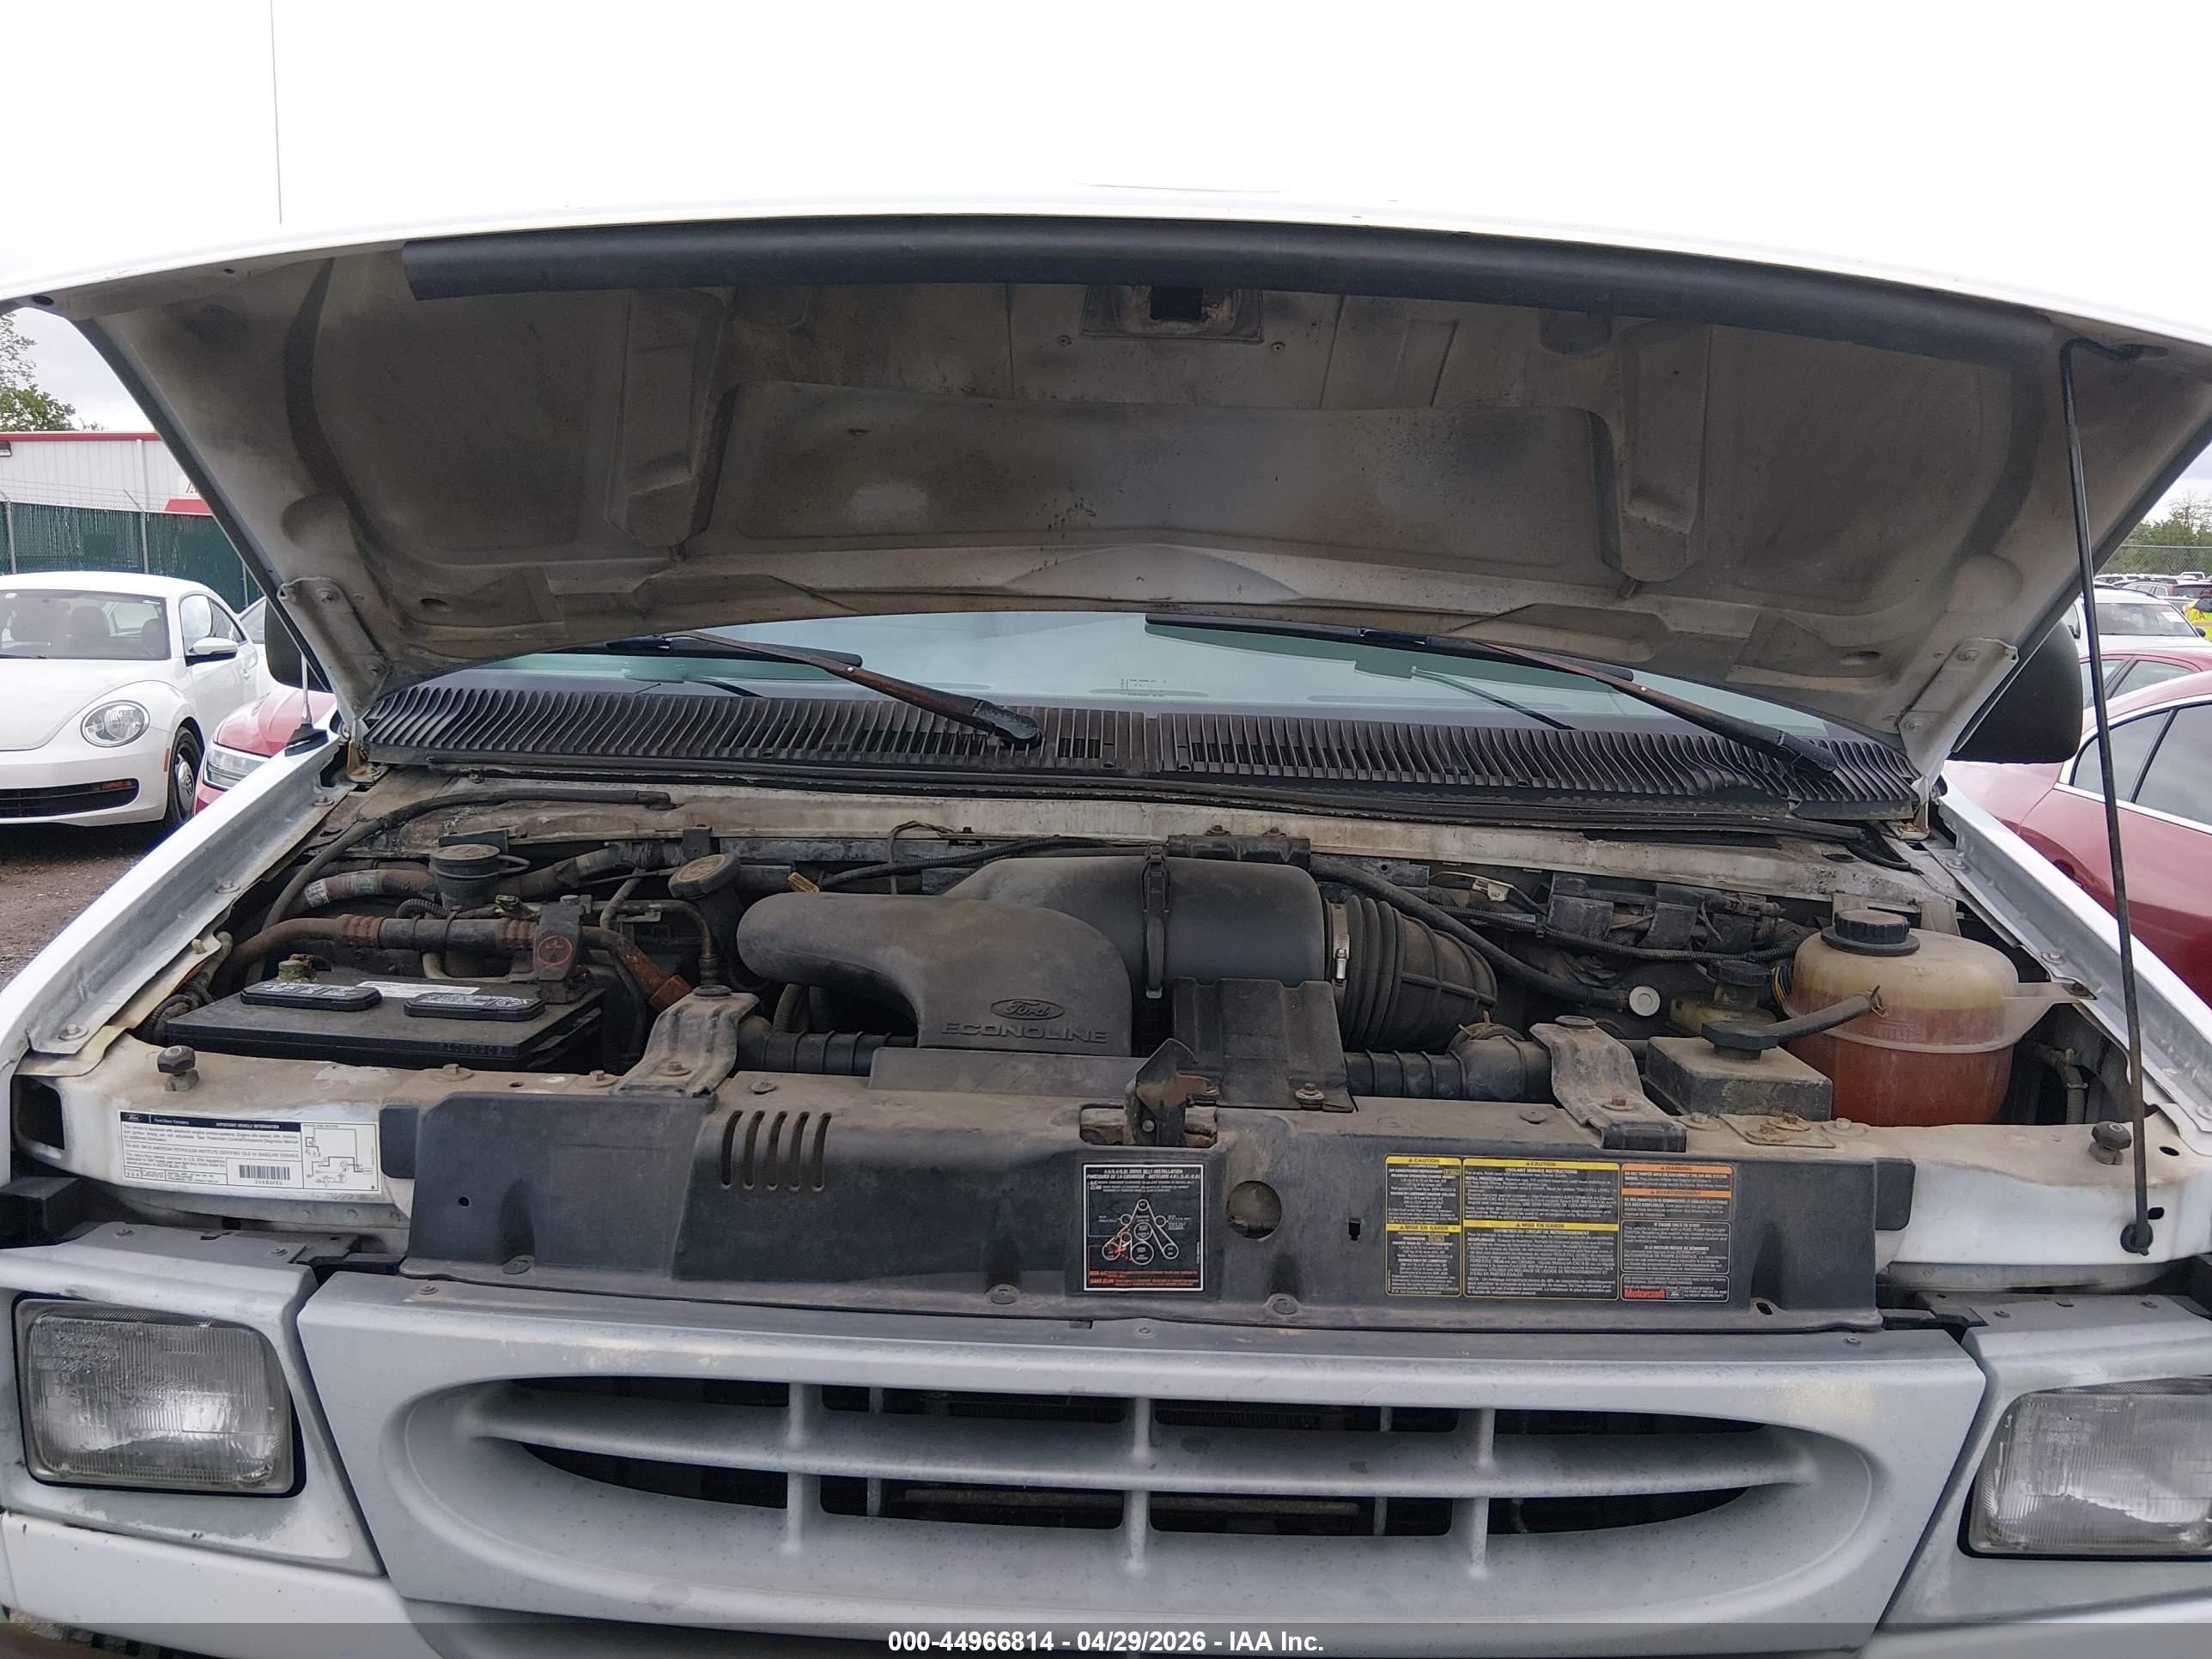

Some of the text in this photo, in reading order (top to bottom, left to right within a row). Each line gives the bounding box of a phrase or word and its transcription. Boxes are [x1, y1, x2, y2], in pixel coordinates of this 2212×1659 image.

[1003, 1000, 1051, 1018] Ford
[942, 1023, 1107, 1044] ECONOLINE
[1624, 1289, 1666, 1298] Motorcraft
